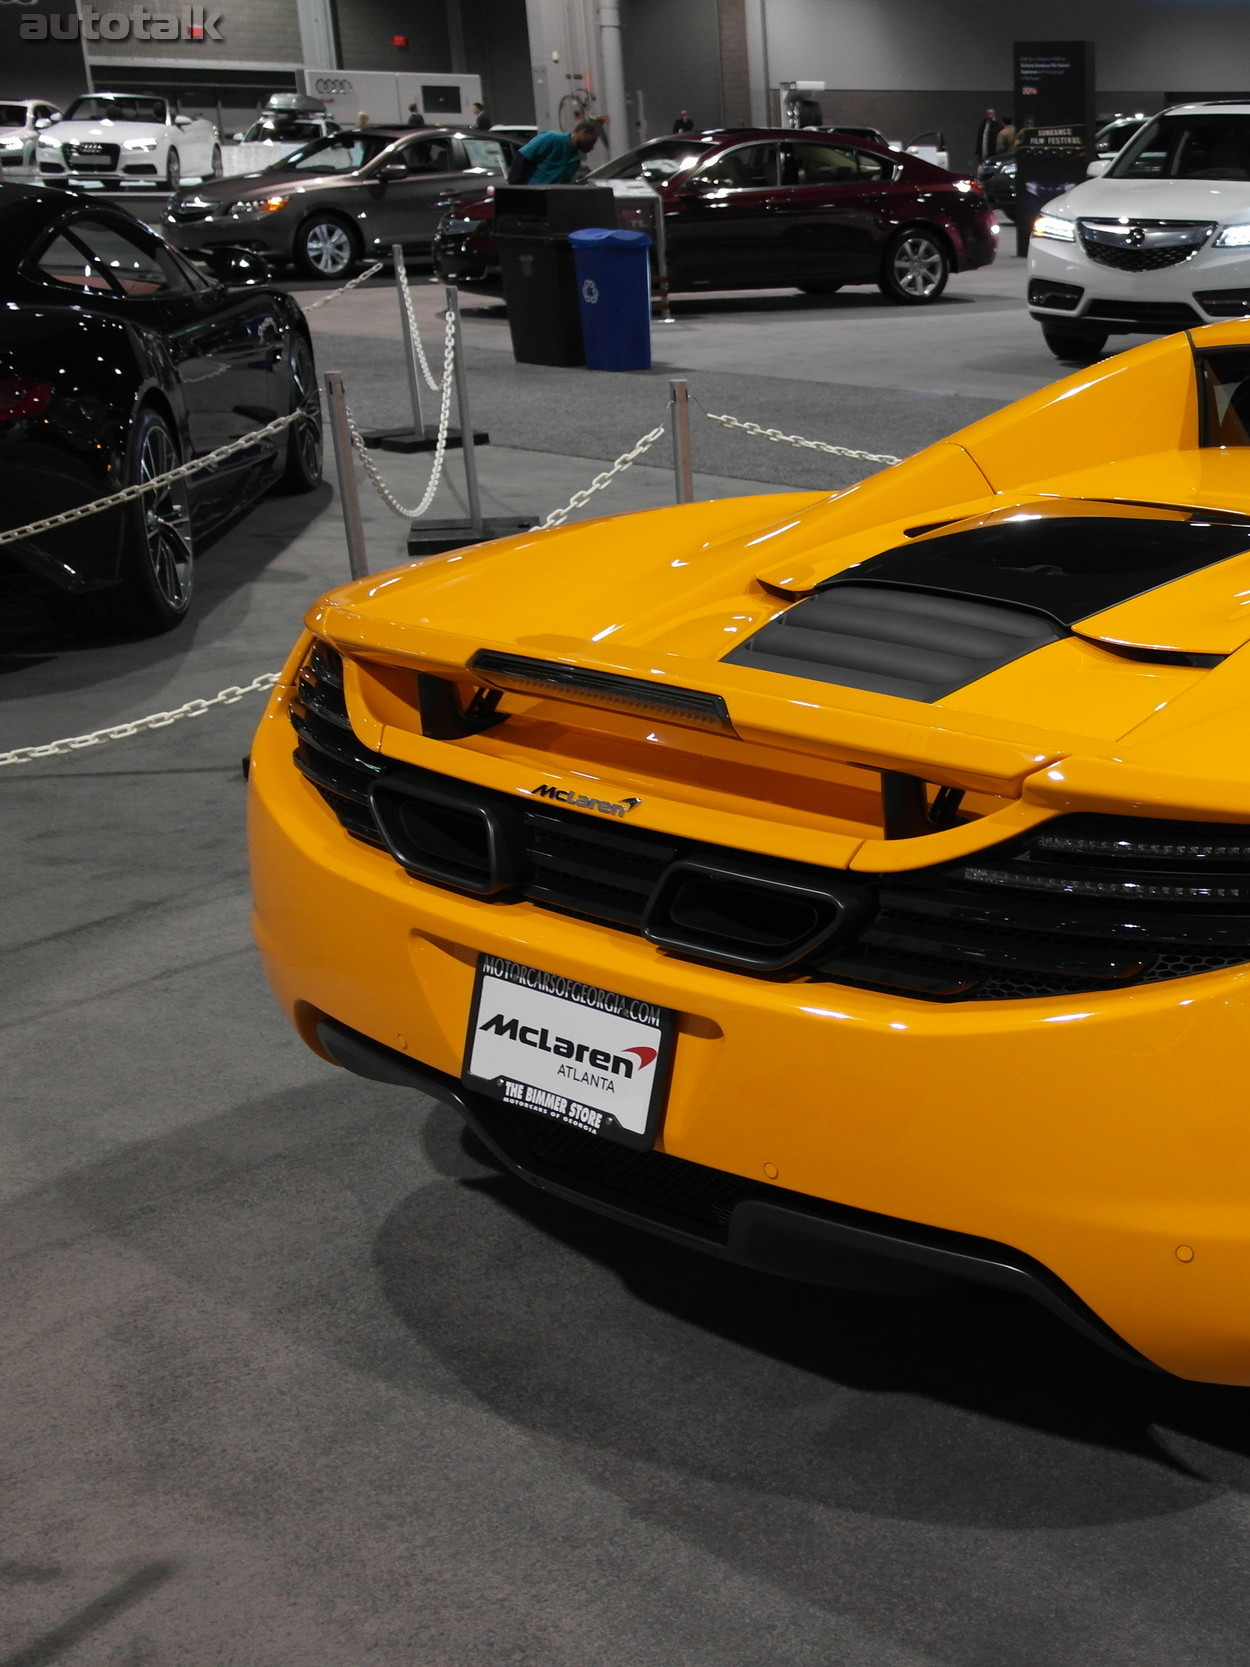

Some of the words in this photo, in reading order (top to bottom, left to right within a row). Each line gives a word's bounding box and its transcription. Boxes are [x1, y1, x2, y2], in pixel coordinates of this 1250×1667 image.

[1030, 137, 1045, 145] FILM
[1047, 137, 1082, 145] FESTIVAL
[1037, 128, 1072, 137] SUNDANCE
[531, 784, 626, 818] McLaren
[482, 955, 661, 1027] MOTORCARSOFGEORGIA.COM
[479, 1013, 634, 1079] McLaren
[557, 1064, 615, 1093] ATLANTA
[503, 1096, 548, 1114] MOTORCARS
[563, 1116, 597, 1135] GEORGIA
[505, 1081, 524, 1100] THE
[525, 1086, 568, 1115] BIMMER
[568, 1102, 603, 1129] STORE
